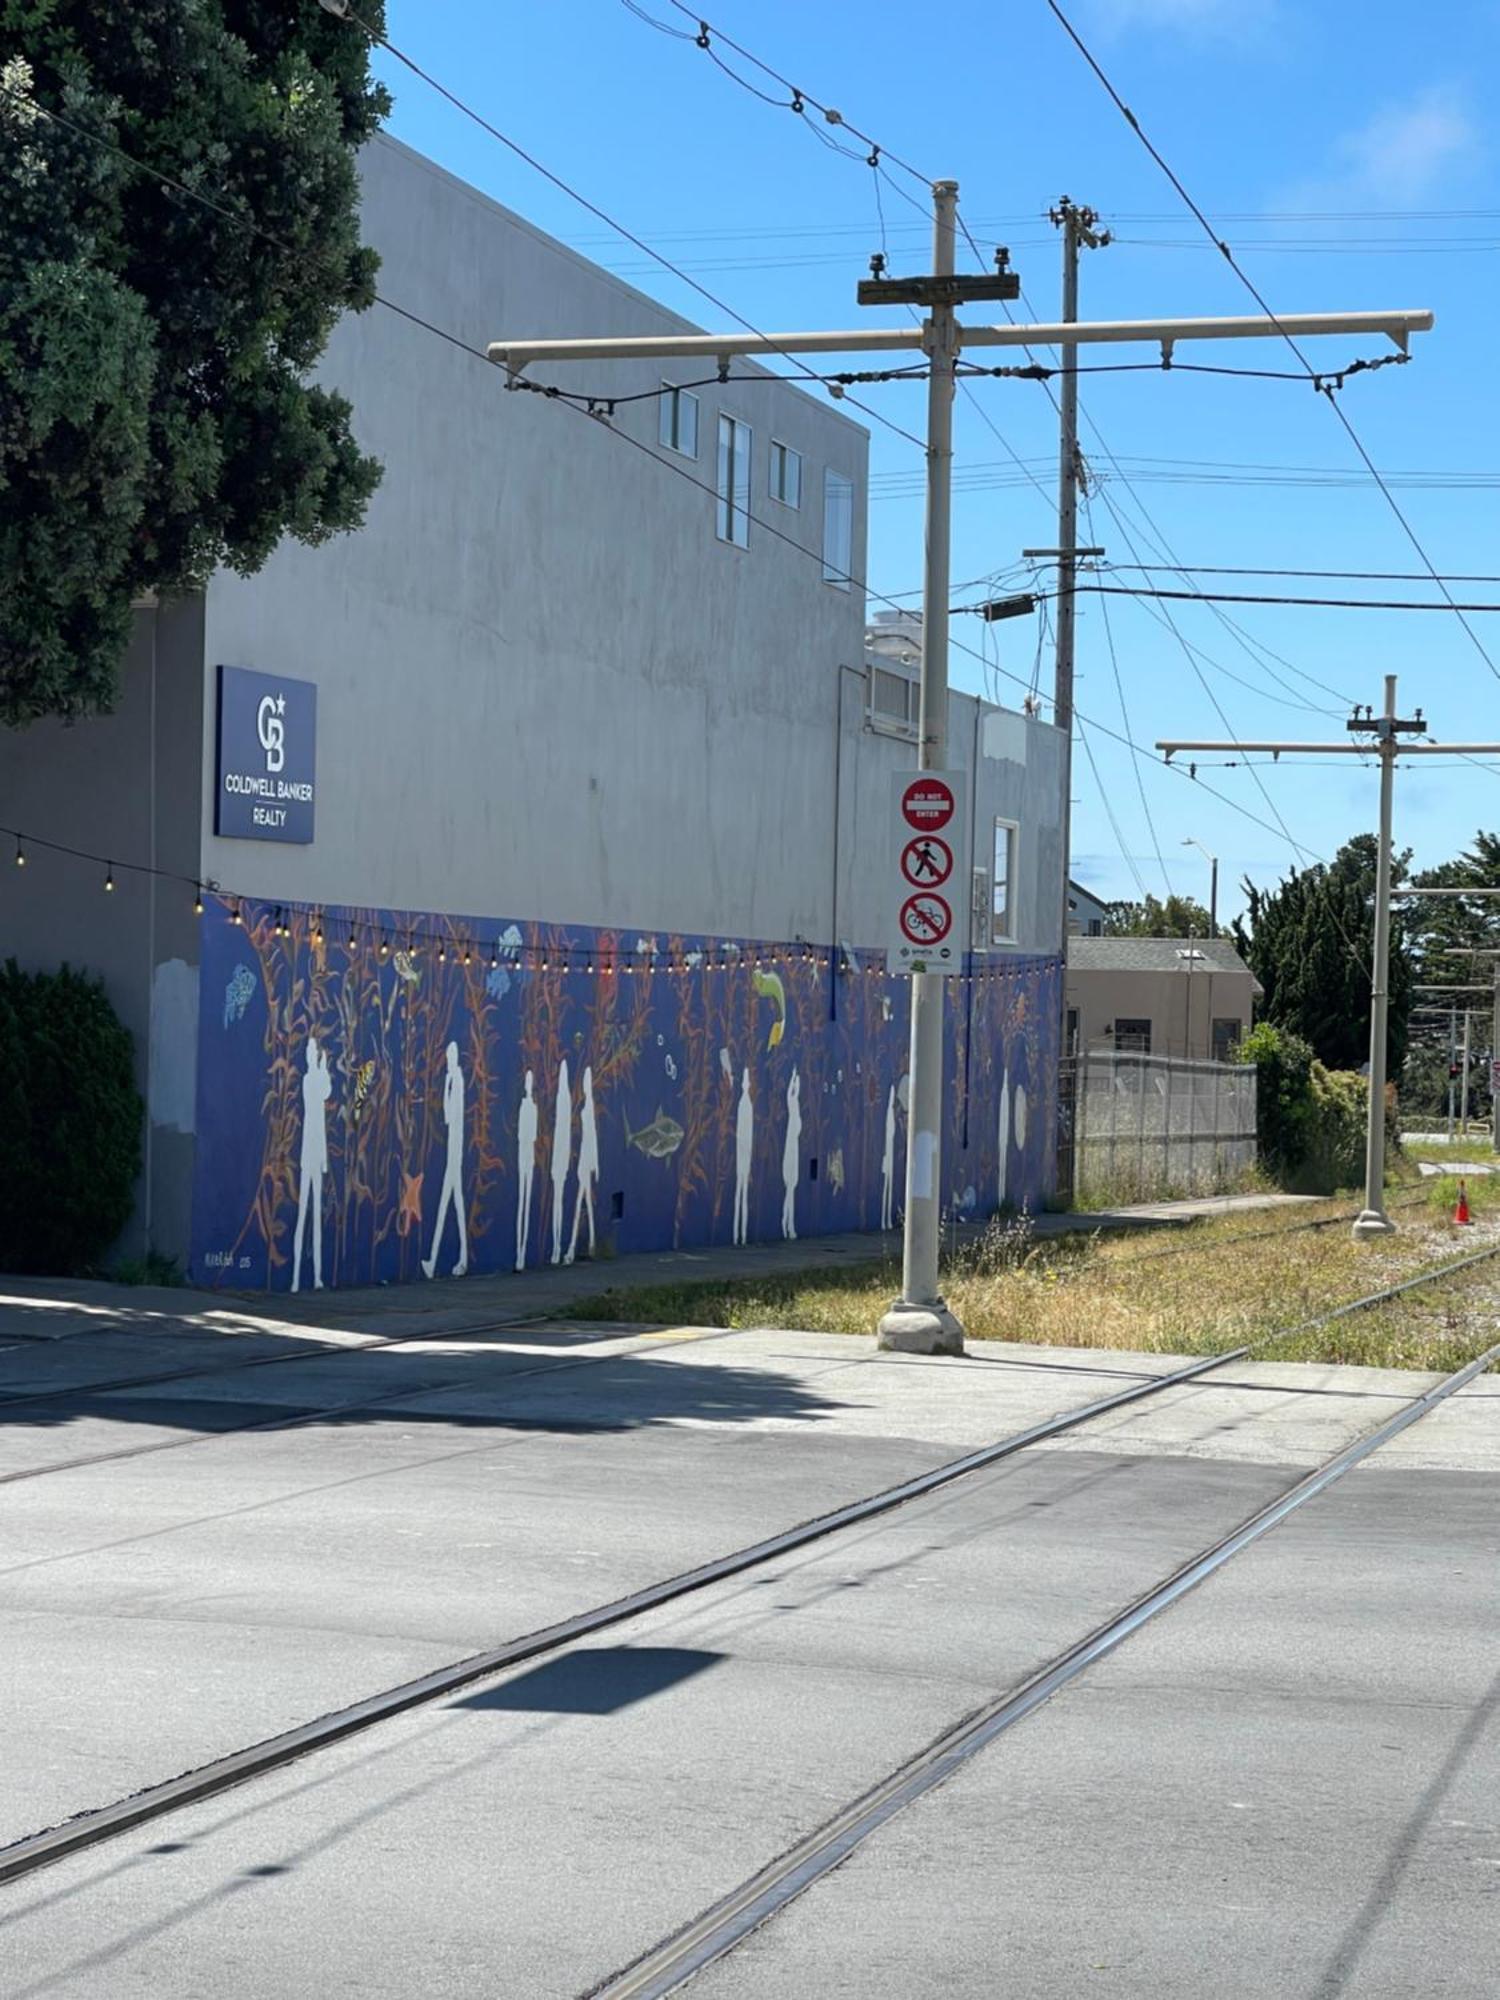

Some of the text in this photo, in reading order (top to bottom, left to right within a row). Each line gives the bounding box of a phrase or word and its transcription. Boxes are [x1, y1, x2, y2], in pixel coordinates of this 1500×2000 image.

[225, 774, 313, 801] COLDWELL BANKER
[253, 807, 286, 826] REALTY
